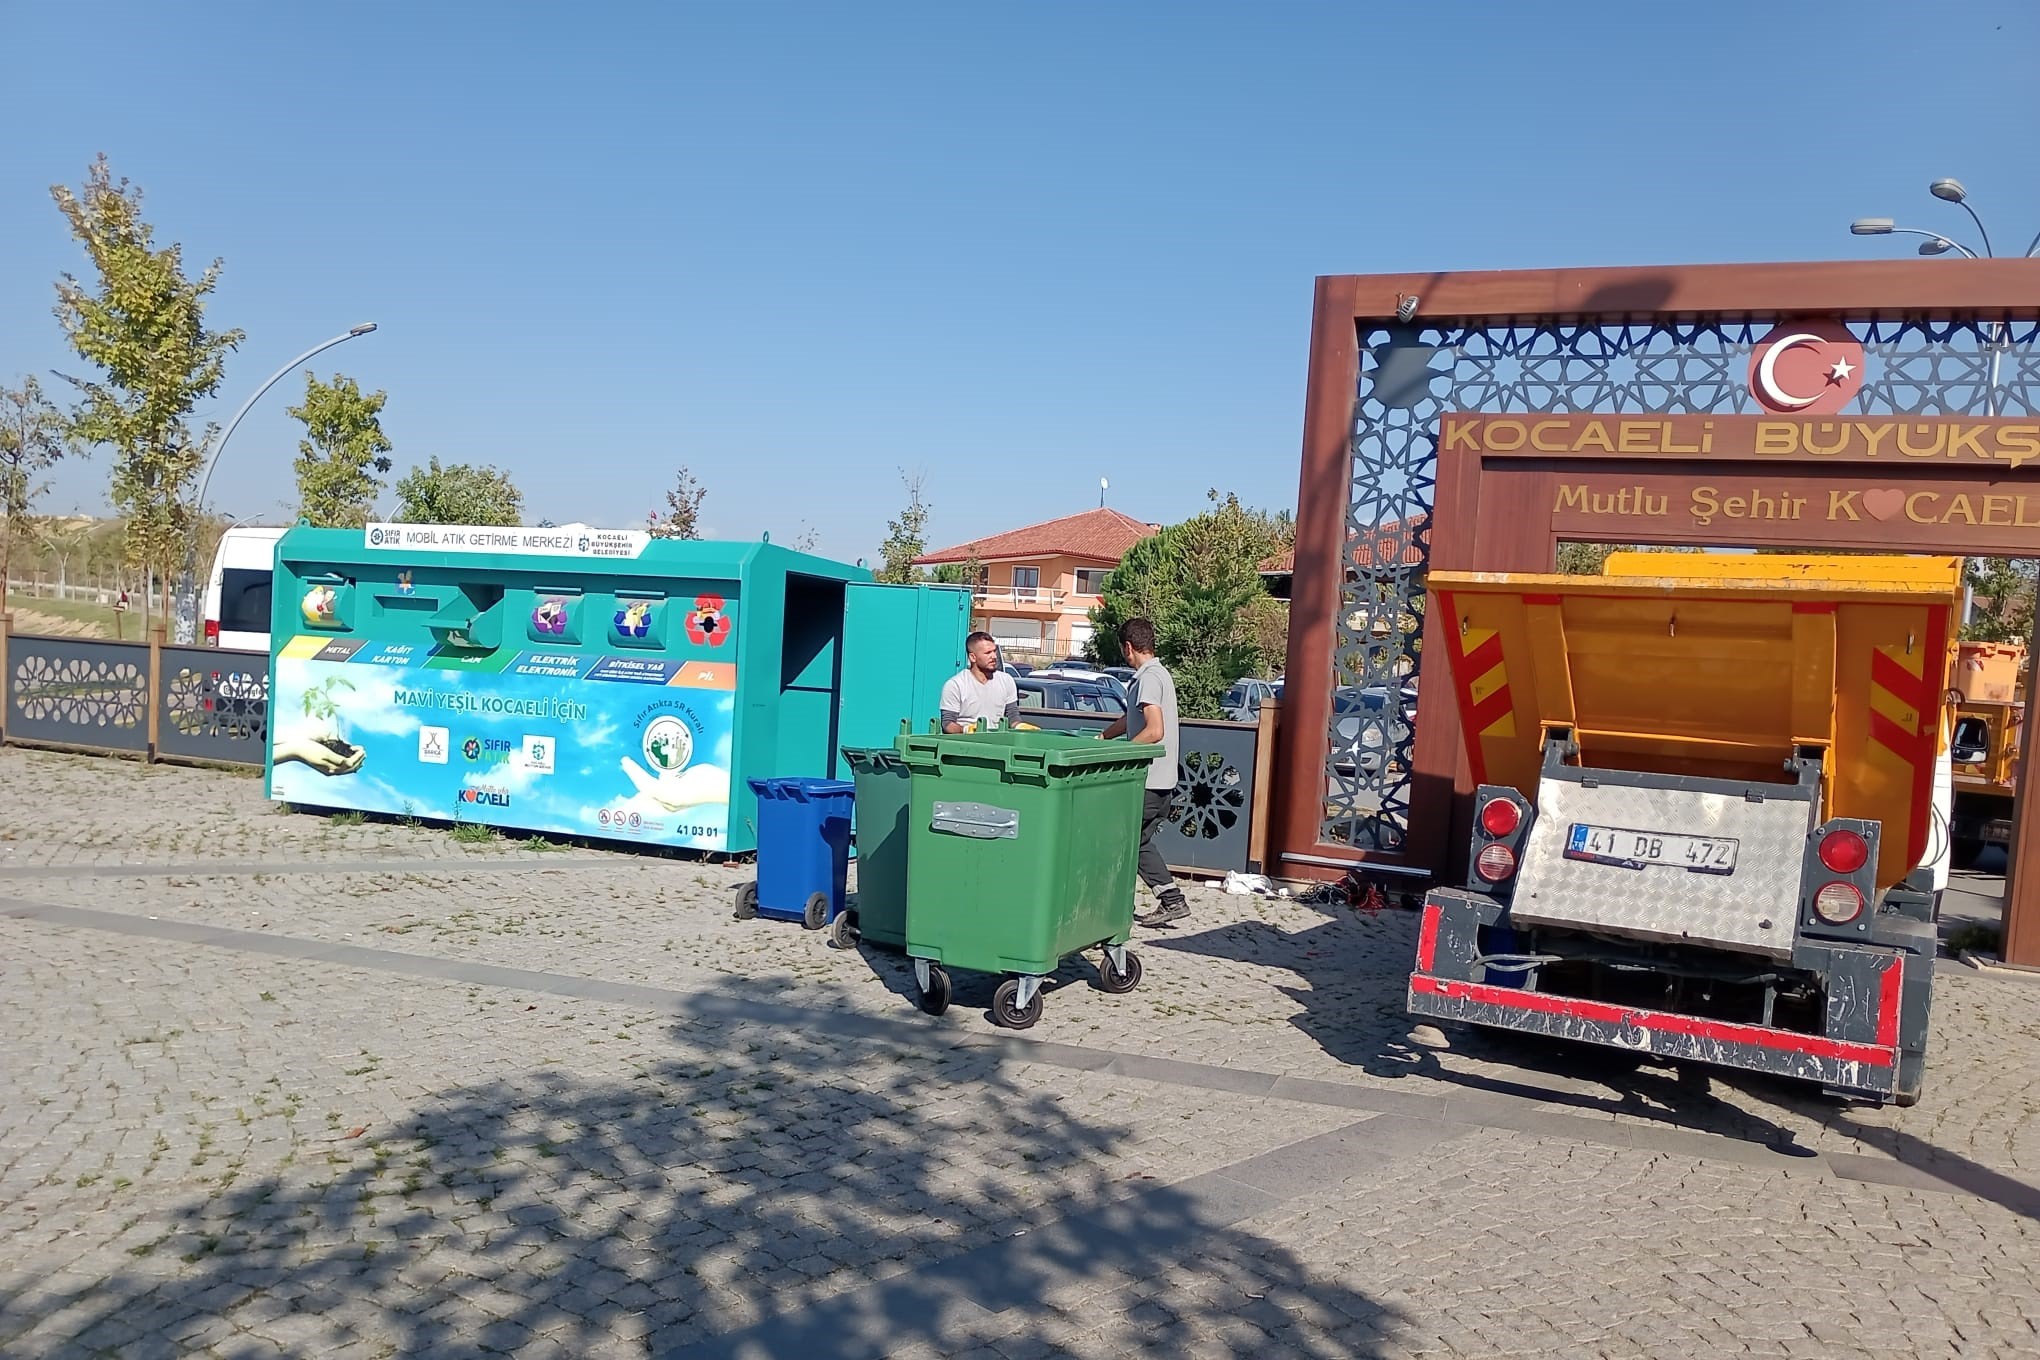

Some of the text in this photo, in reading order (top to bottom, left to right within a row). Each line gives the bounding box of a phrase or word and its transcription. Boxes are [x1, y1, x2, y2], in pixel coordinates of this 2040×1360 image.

[1553, 484, 2040, 527] Mutlu Şehir KCAEL
[384, 529, 401, 537] SIFIR
[384, 537, 401, 545] ATIK
[406, 531, 573, 549] MOBİL ATIK GETİRME MERKEZİ
[324, 646, 352, 655] METAL
[371, 655, 410, 665] KARTON
[529, 655, 581, 667] ELEKTRİK
[607, 659, 646, 670] BİTKİSEL
[515, 664, 578, 677] ELEKTRONİK
[697, 670, 715, 682] PİL
[394, 688, 586, 722] MAVİ YEŞİL KOCAELİ İÇİN
[647, 700, 673, 713] Atıkta
[685, 707, 705, 734] Kuralı
[484, 738, 511, 752] SIFIR
[676, 824, 688, 836] 41
[691, 825, 704, 837] 03
[706, 827, 718, 838] 01
[1572, 840, 1585, 852] TR
[1589, 831, 1731, 865] 41 DB 472
